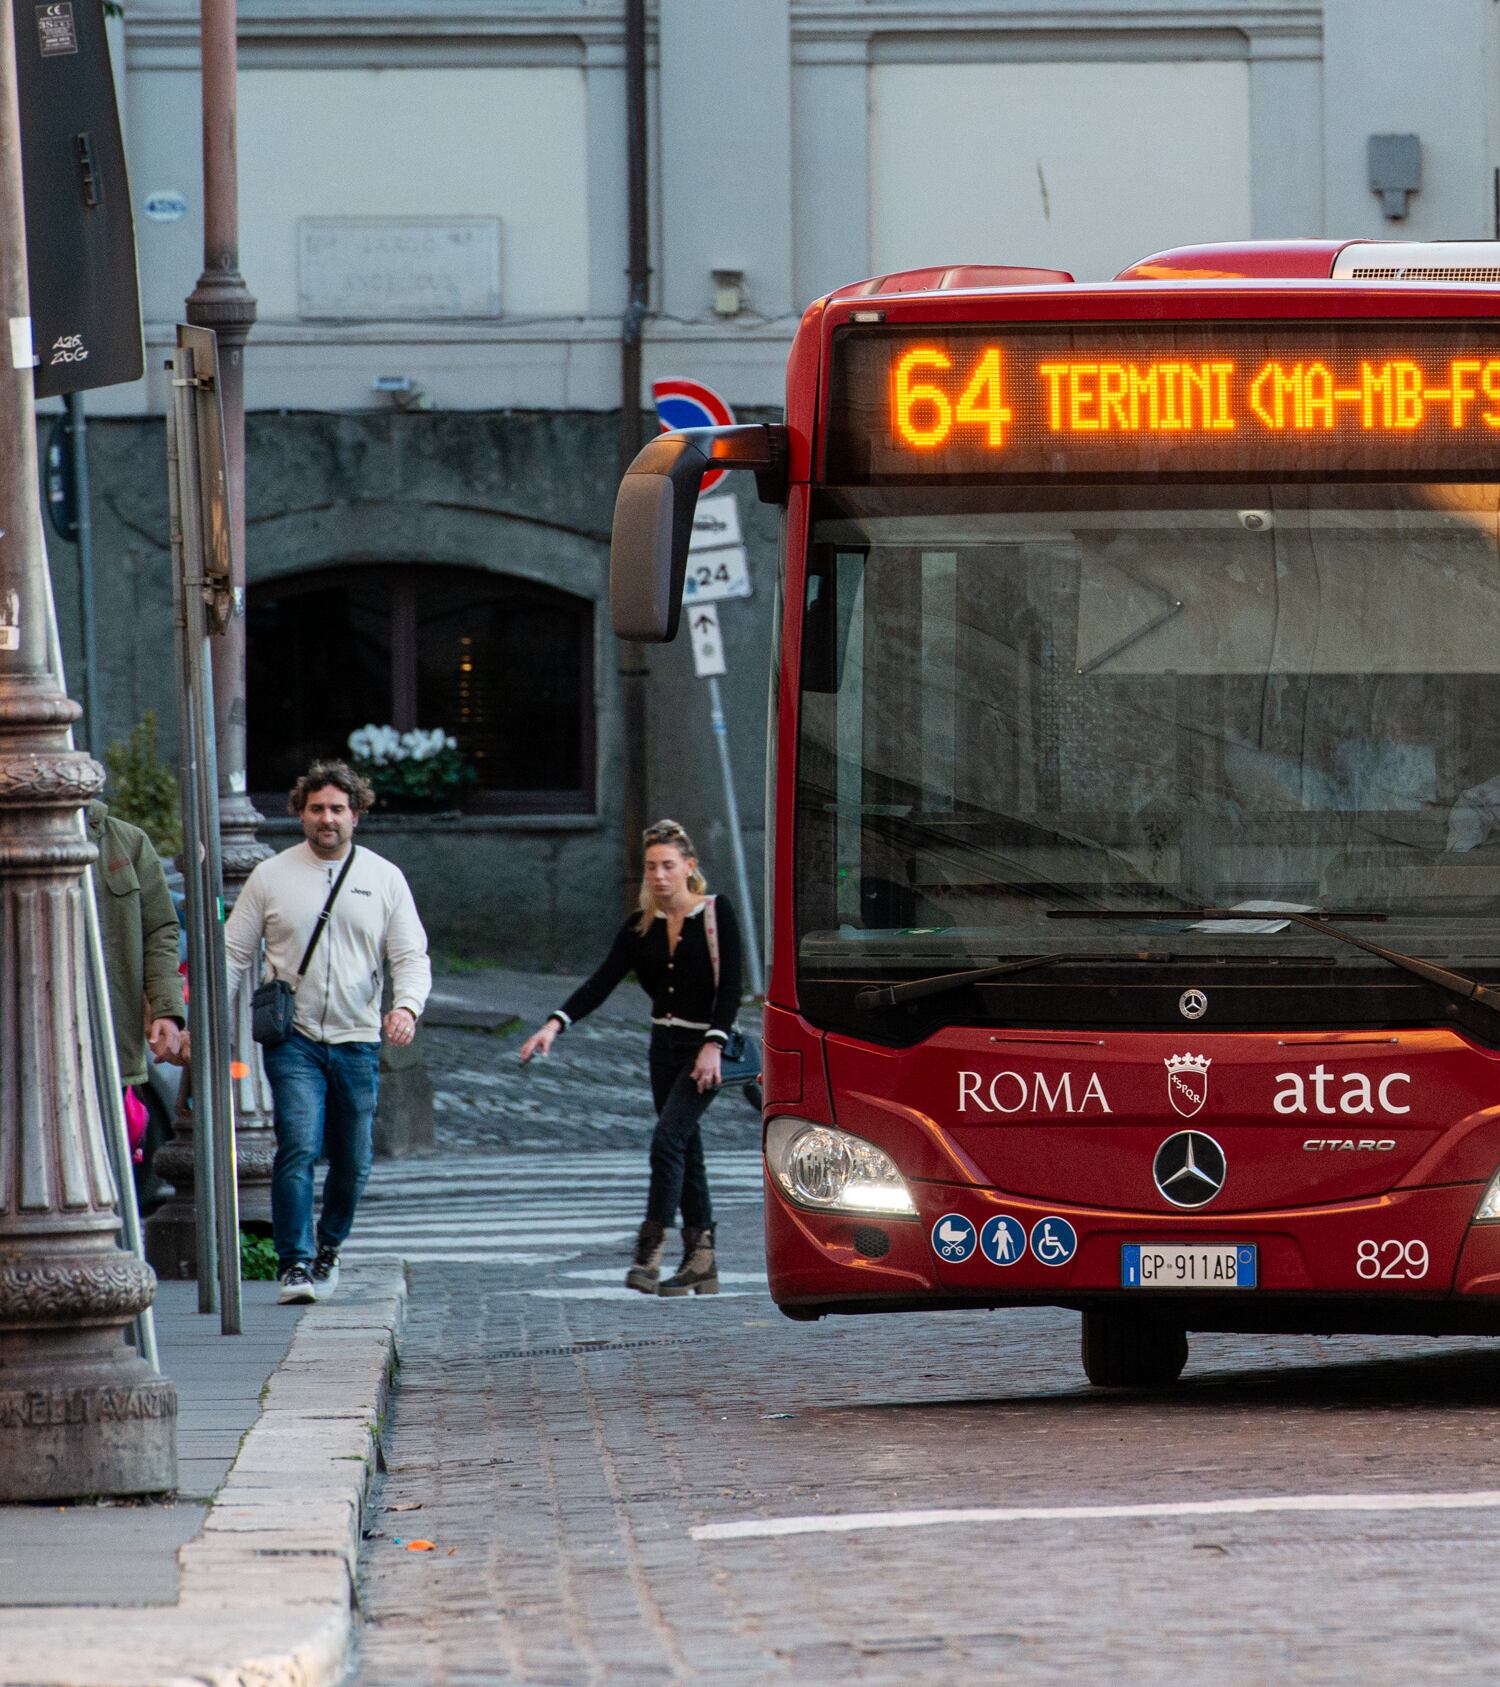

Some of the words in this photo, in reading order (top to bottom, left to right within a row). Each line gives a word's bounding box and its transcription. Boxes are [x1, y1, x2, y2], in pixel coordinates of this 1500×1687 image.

[896, 348, 1012, 446] 64
[1041, 364, 1235, 430] TERMINI
[957, 1071, 1113, 1113] ROMA
[1273, 1063, 1411, 1114] atac
[1302, 1139, 1396, 1151] CITARO
[1356, 1239, 1429, 1279] 829
